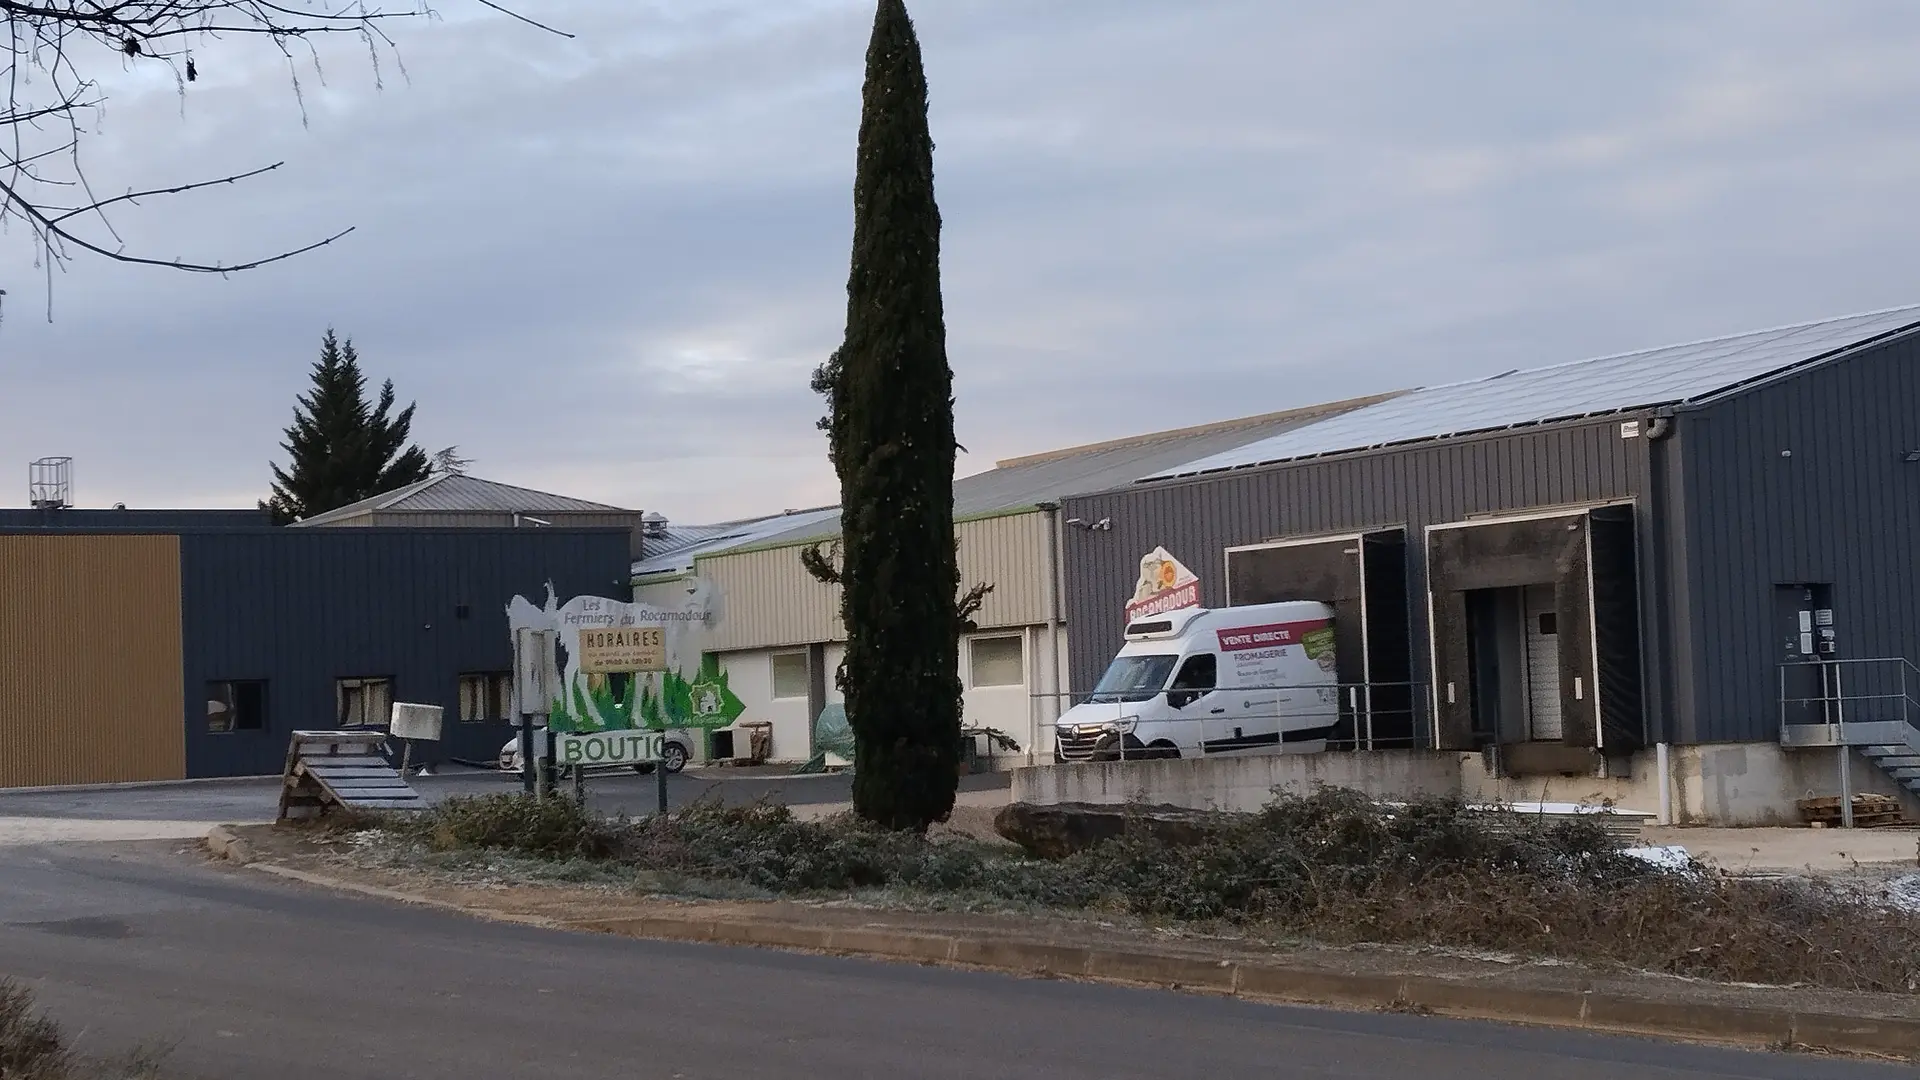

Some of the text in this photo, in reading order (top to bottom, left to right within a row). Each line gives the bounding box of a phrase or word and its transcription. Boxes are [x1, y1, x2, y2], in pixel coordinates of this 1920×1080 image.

[583, 599, 601, 611] Les
[1130, 585, 1196, 622] ROCAMADOUR
[564, 609, 712, 627] Fermiers du Rocamadour
[587, 631, 659, 648] HORAIRES
[1222, 630, 1291, 646] VENTE DIRECTE
[1233, 648, 1288, 661] FROMAGERIE
